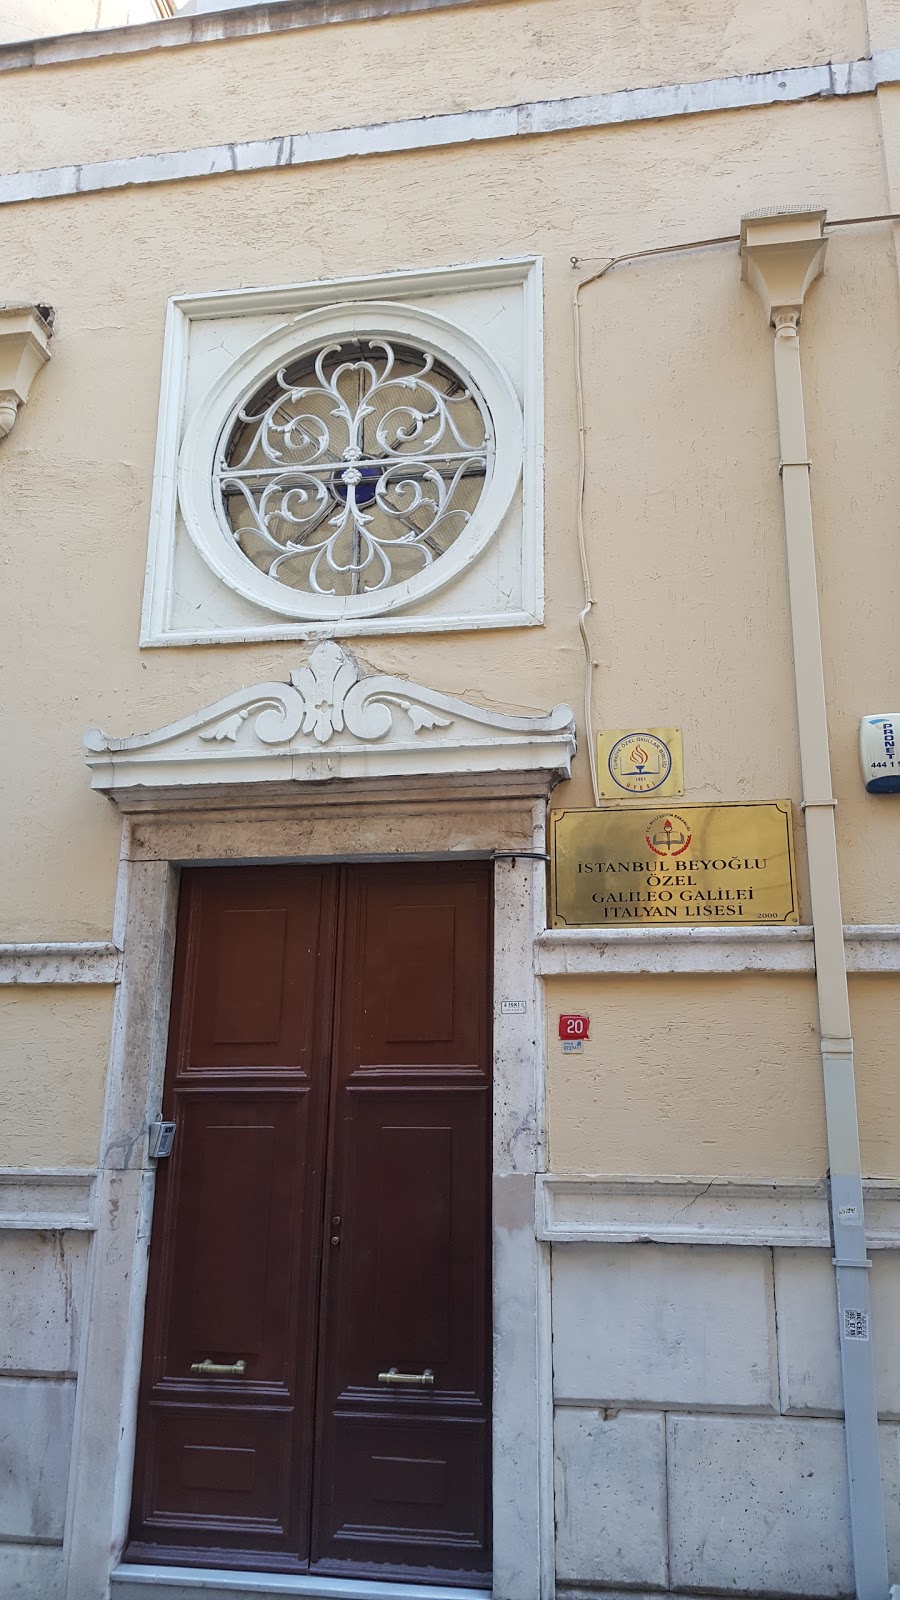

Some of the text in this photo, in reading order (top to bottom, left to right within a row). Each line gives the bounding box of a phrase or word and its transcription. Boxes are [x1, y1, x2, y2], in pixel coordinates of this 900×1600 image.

[636, 737, 660, 749] OKULLAR
[883, 723, 895, 759] PRONET
[577, 856, 768, 874] İSTANBUL BEYOĞLU
[646, 873, 698, 887] ÖZEL
[592, 886, 755, 903] GALİLEO GALİLEİ
[603, 902, 745, 918] İTALYAN LİSESİ
[567, 1019, 583, 1034] 20
